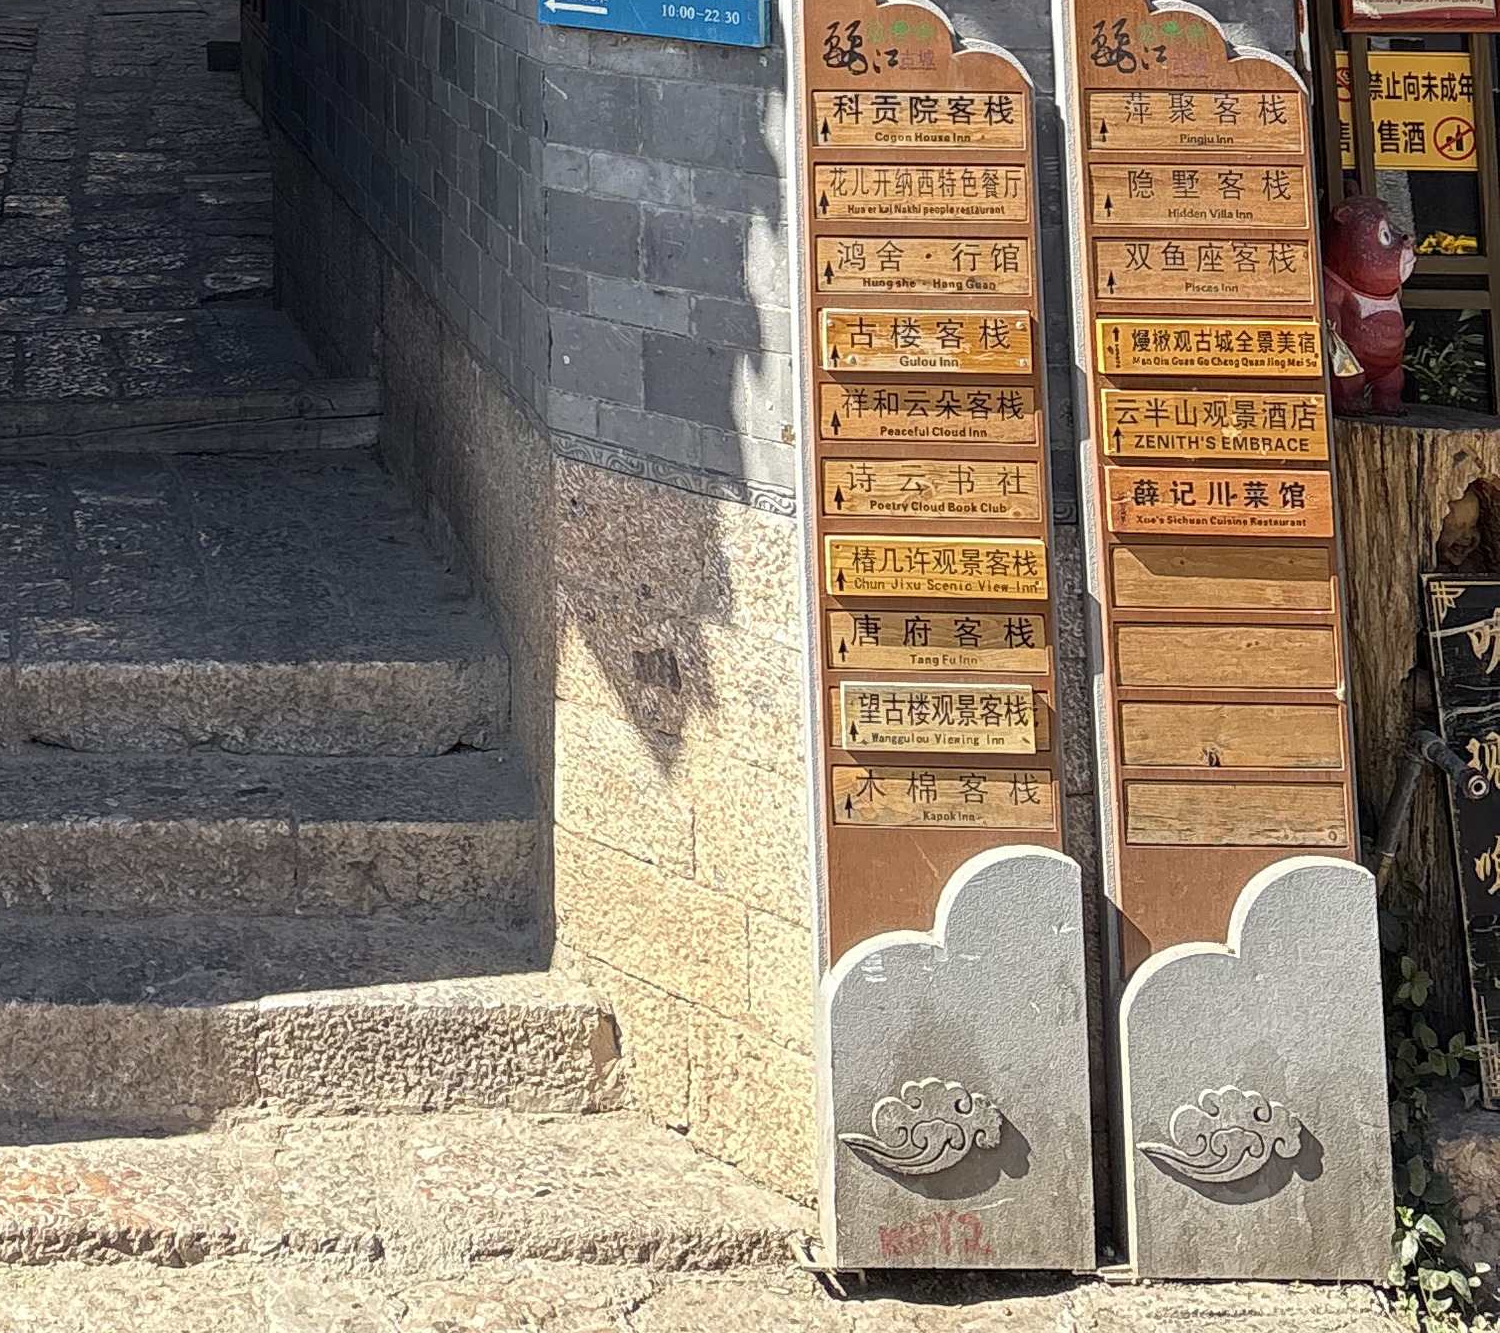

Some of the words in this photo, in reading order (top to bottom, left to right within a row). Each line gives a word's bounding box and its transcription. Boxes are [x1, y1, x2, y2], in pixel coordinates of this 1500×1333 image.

[662, 4, 740, 25] 10:00-2230
[832, 93, 1015, 127] 科贡院客栈
[1122, 92, 1288, 126] 萍聚客栈
[875, 132, 913, 146] Cogon
[915, 132, 951, 143] House
[953, 133, 971, 143] Inn
[1180, 133, 1215, 146] Pingju
[1217, 134, 1234, 144] Inn
[830, 167, 1021, 199] 花儿开纳西特色餐厅
[1127, 169, 1292, 202] 隐墅客栈
[848, 204, 866, 215] Hua
[894, 204, 922, 215] Nakhi
[923, 205, 954, 217] people
[956, 205, 1005, 216] restaurant
[1168, 209, 1207, 219] Hidden
[1209, 209, 1233, 219] Villa
[1236, 209, 1253, 220] Inn
[1124, 241, 1297, 275] 双鱼座客栈
[863, 278, 893, 290] Hung
[896, 278, 916, 288] she
[1222, 283, 1239, 293] Inn
[845, 317, 1011, 351] 古楼客栈
[900, 356, 937, 367] Gulou
[939, 356, 959, 367] Inn
[1288, 358, 1304, 368] Mei
[841, 387, 1025, 421] 祥和云朵客栈
[1113, 397, 1317, 431] 云半山观景酒店
[880, 426, 930, 437] Peaceful
[932, 427, 966, 437] Cloud
[968, 427, 988, 438] Inn
[1134, 434, 1217, 450] ZENITH'S
[1221, 436, 1311, 452] EMBRACE
[846, 463, 1029, 496] 诗云书社
[1132, 479, 1307, 510] 薛记川菜馆
[869, 499, 909, 512] Poetry
[911, 501, 946, 513] Cloud
[948, 502, 978, 513] Book
[980, 502, 1007, 513] Club
[1166, 515, 1208, 525] Sichuan
[1209, 515, 1248, 526] Cuisine
[1250, 517, 1307, 527] Restaurant
[852, 546, 1038, 577] 椿几许观景客栈
[854, 577, 886, 590] Chun
[891, 578, 922, 591] Jixu
[978, 579, 1009, 593] View
[1015, 579, 1039, 593] Inn
[851, 614, 1036, 649] 唐府客栈
[910, 654, 940, 667] Tang
[942, 655, 956, 664] Fu
[958, 655, 978, 666] Inn
[858, 692, 1030, 727] 望古楼观景客栈
[871, 733, 929, 745] Wanggulou
[934, 733, 980, 745] Viewing
[986, 734, 1005, 745] Inn
[856, 769, 1040, 806] 木棉客栈
[923, 811, 956, 822] Kapok
